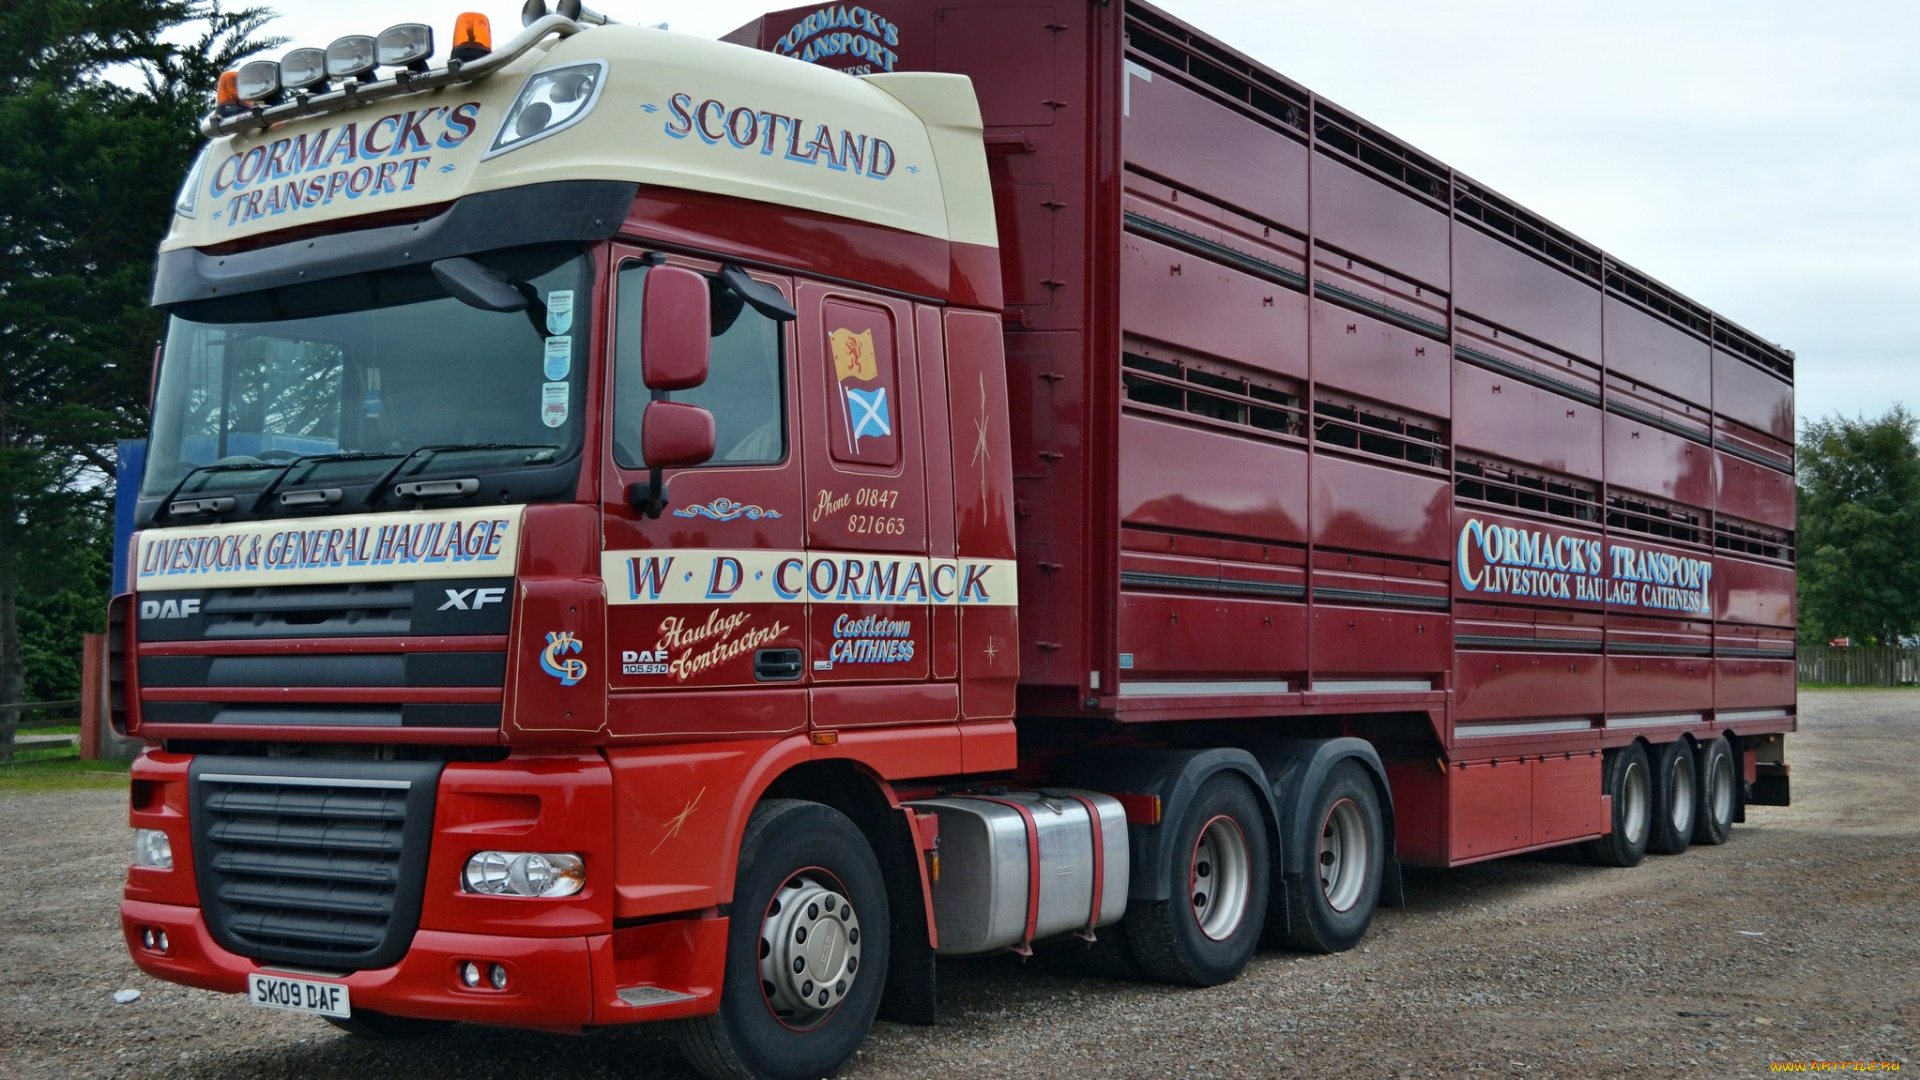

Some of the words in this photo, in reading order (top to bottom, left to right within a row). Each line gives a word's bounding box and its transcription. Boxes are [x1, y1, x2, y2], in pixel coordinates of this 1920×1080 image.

[772, 5, 899, 56] CORMACK'S
[788, 32, 898, 73] ANSPORT
[210, 102, 481, 198] CORMACK'S
[665, 93, 896, 181] SCOTLAND
[228, 156, 431, 227] TRANSPORT
[812, 489, 851, 522] Phone
[856, 488, 898, 509] 01847
[848, 514, 905, 535] 821663
[140, 534, 249, 577] LIVESTOCK
[245, 533, 262, 571] &
[264, 526, 372, 571] GENERAL
[371, 520, 510, 565] HAULAGE
[1458, 518, 1601, 592] CORMACK'S
[1610, 545, 1712, 614] TRANSPORT
[436, 587, 507, 611] XF
[626, 556, 675, 600] W
[705, 556, 744, 600] D
[773, 556, 993, 602] CORMACK
[1484, 565, 1571, 599] LIVESTOCK
[1576, 576, 1638, 605] HAULAGE
[1642, 584, 1700, 613] CAITHNESS
[140, 598, 201, 620] DAF
[655, 608, 751, 650] Haulage
[833, 613, 911, 638] Castletown
[622, 651, 668, 663] DAF
[624, 664, 667, 674] 105.510
[668, 620, 790, 682] Contractors
[830, 639, 915, 663] CAITHNESS
[256, 978, 302, 1006] SK09
[306, 984, 340, 1011] DAF
